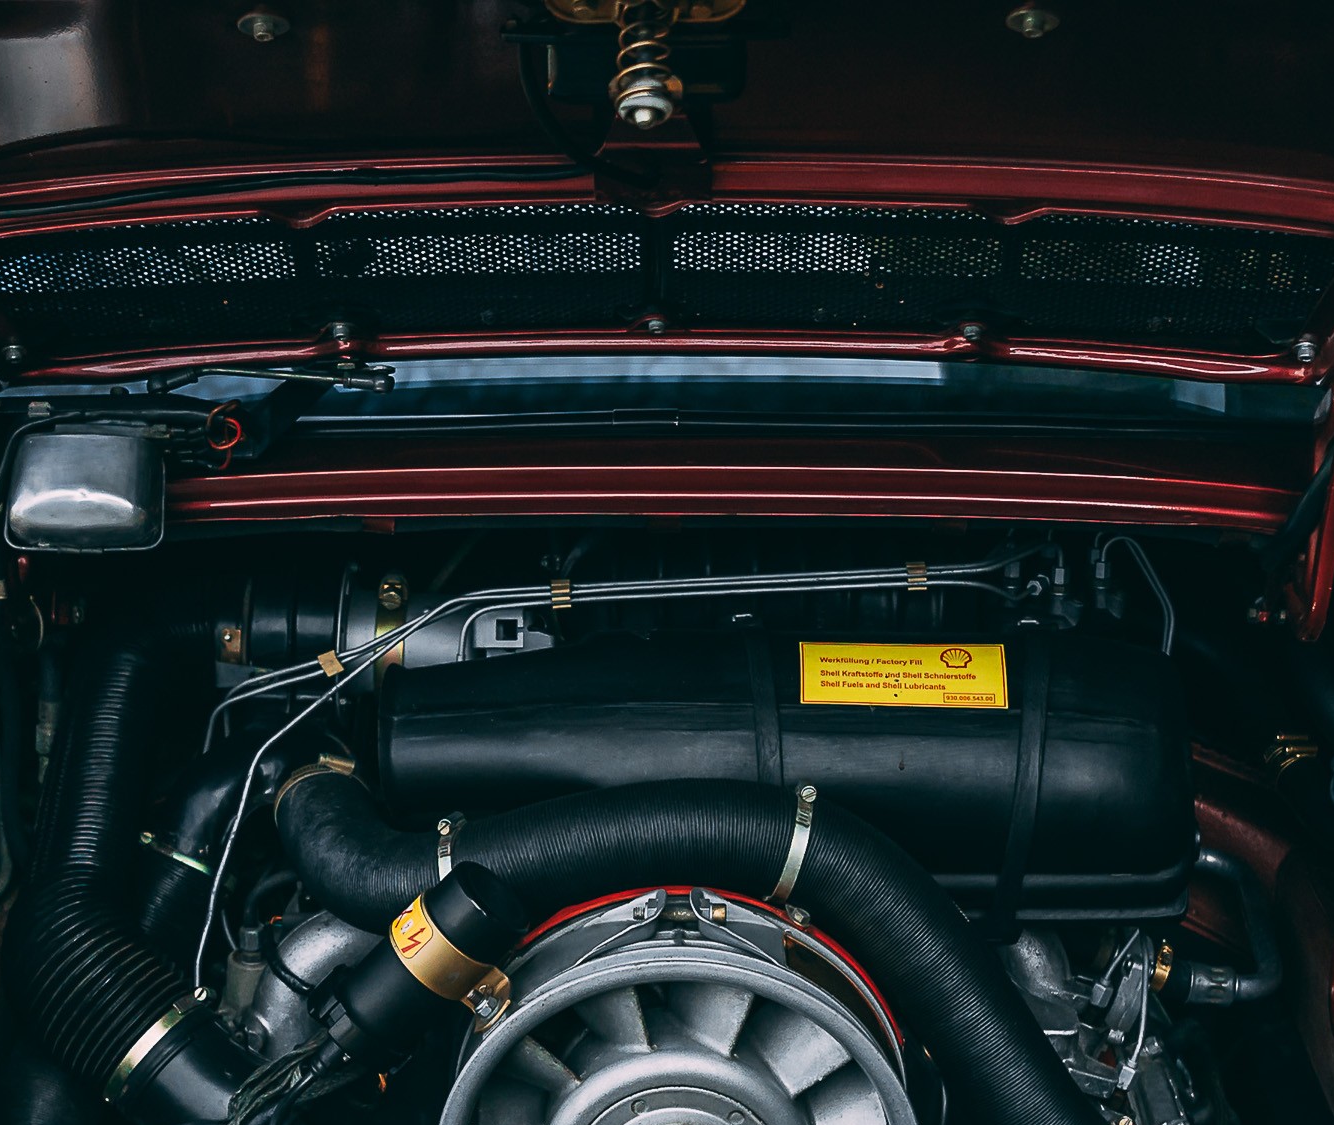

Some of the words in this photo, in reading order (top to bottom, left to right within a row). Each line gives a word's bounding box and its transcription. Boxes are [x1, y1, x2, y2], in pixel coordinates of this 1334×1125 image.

[819, 656, 870, 666] Werkfüllung
[876, 658, 908, 667] Factory
[820, 669, 840, 677] Shell
[841, 670, 884, 678] Kraftstoffe
[820, 680, 840, 688] Shell
[904, 683, 946, 691] Lubricants
